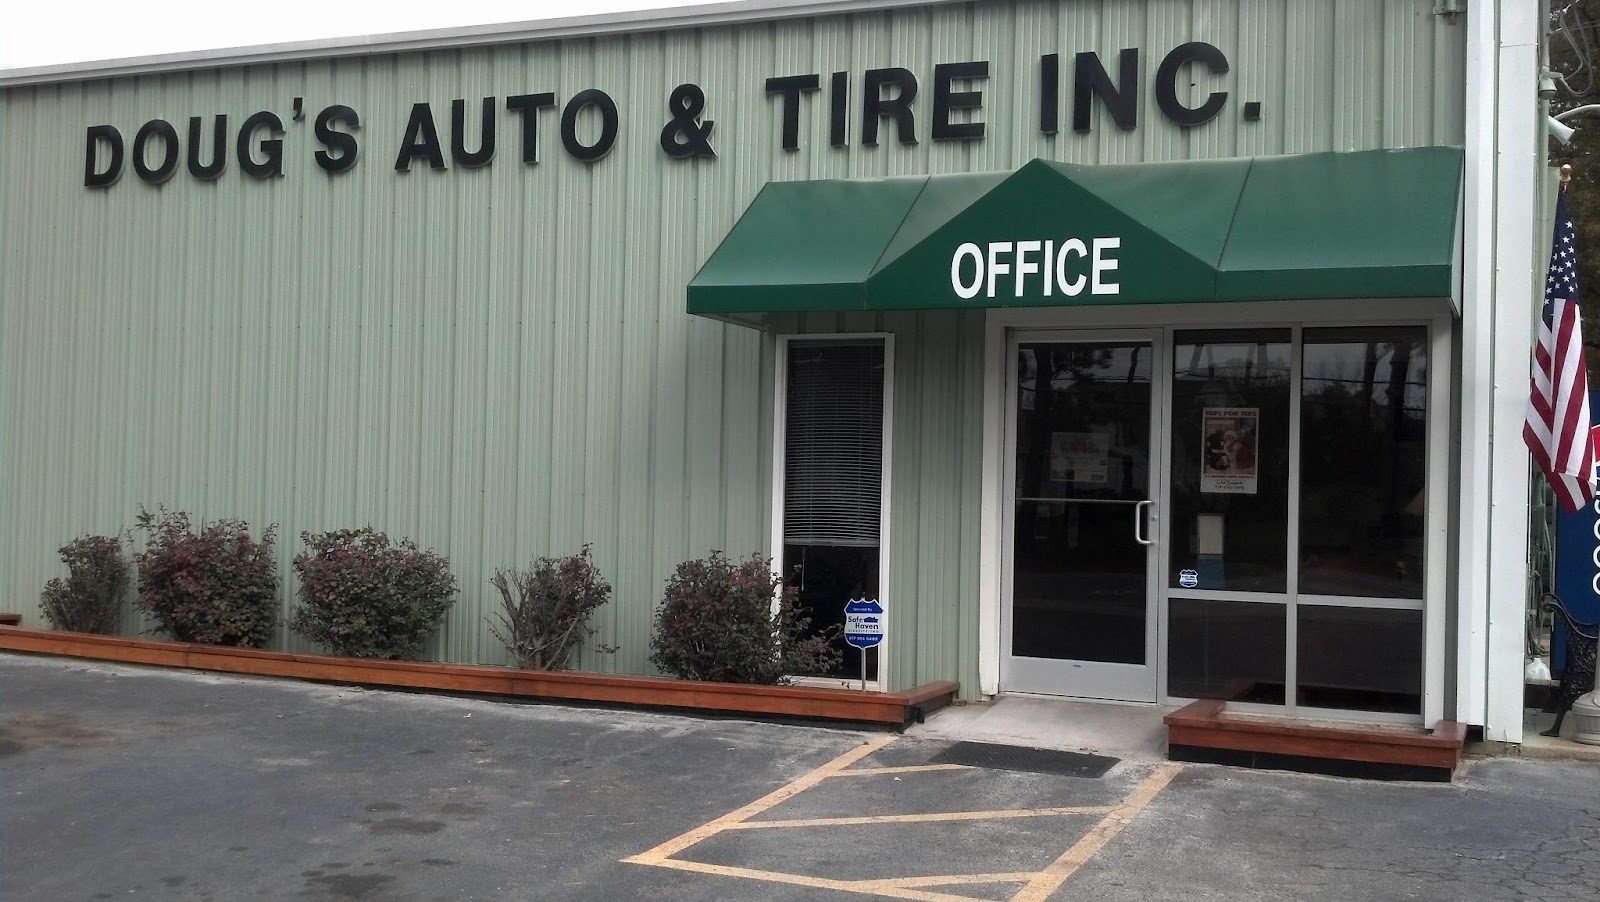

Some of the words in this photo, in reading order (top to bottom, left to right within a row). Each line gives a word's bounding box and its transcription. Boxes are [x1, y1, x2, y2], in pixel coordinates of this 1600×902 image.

[84, 97, 362, 192] DOUG'S
[394, 88, 619, 174] AUTO
[660, 83, 717, 164] &
[765, 60, 991, 153] TIRE
[1040, 41, 1261, 141] INC.
[951, 236, 1121, 300] OFFICE
